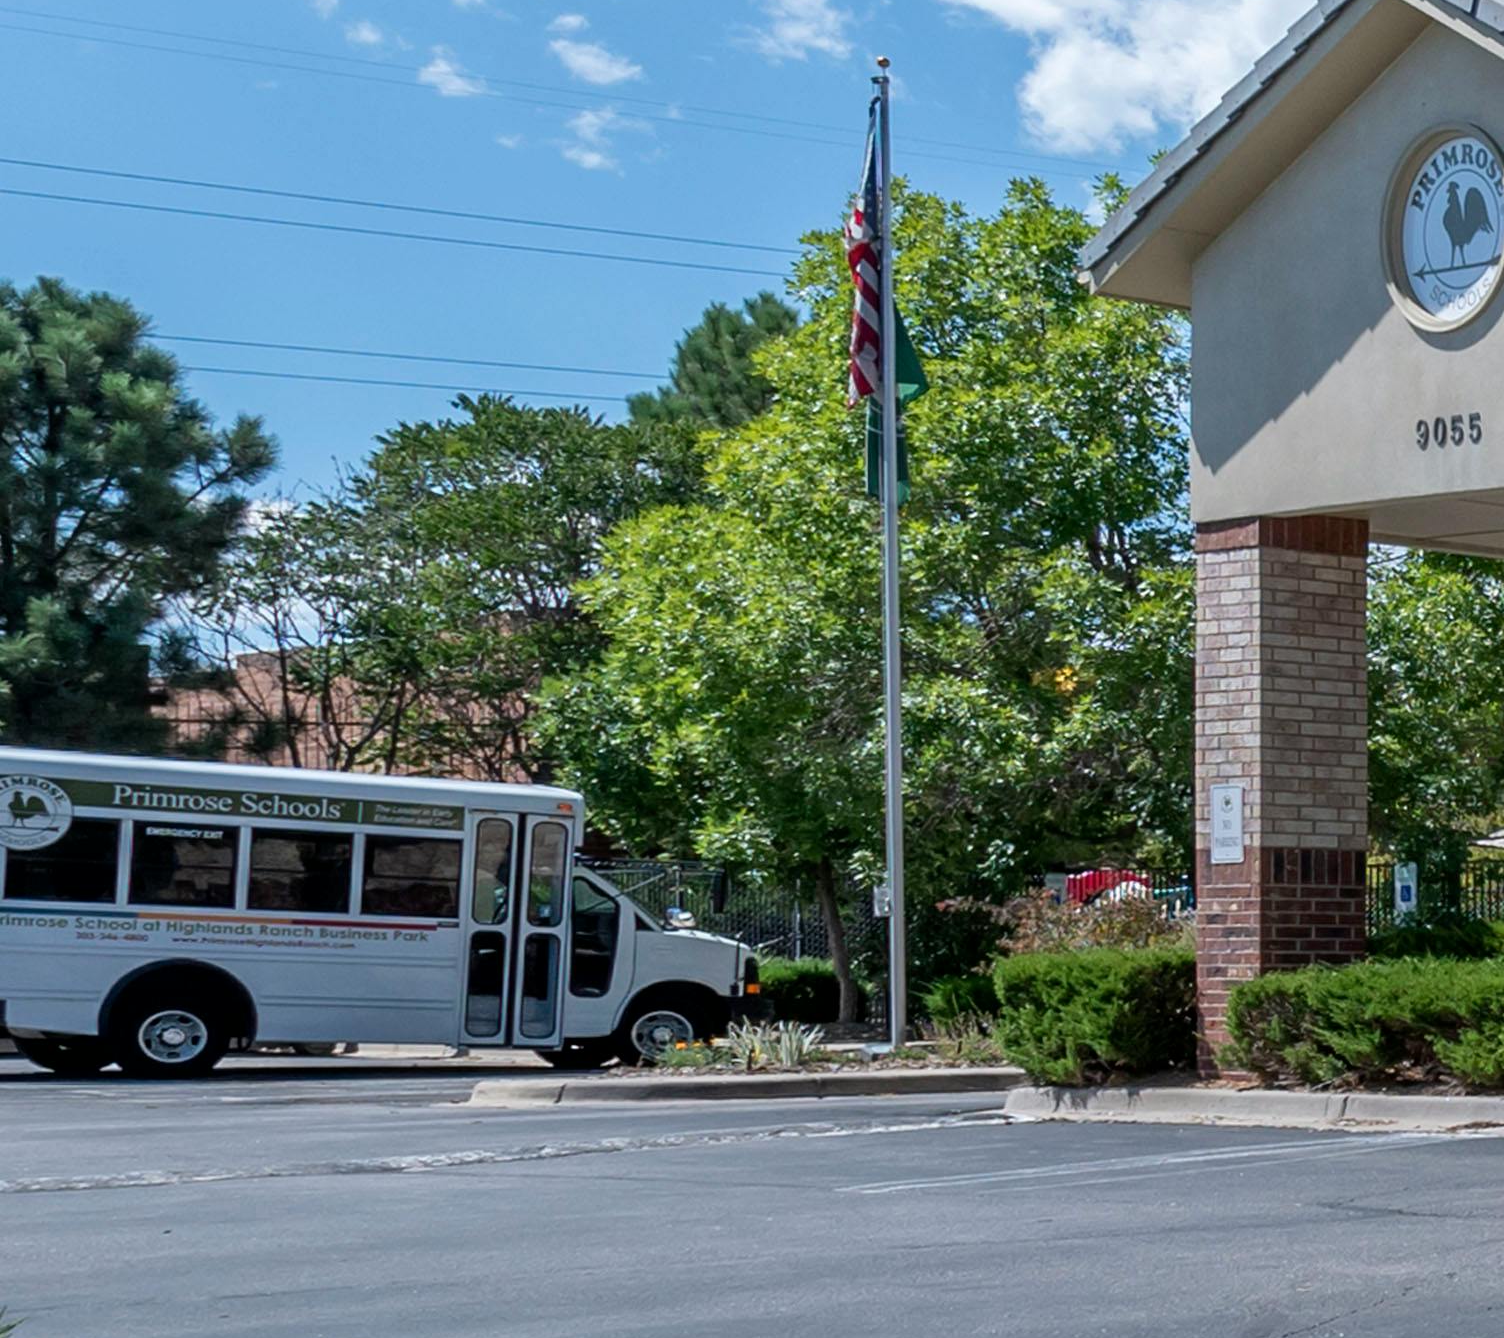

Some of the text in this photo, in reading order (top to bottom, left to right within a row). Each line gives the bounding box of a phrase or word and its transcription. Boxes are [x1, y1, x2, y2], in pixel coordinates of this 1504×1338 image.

[1411, 143, 1504, 212] PRIMROSE
[1429, 277, 1494, 310] SCHOOLS
[1416, 412, 1482, 452] 9055
[0, 776, 66, 803] IMROSE
[112, 784, 342, 819] Primrose Schools
[146, 826, 224, 840] EMERGENCY EXIT
[0, 914, 429, 943] rimrose School at Highlands Ranch Business Park
